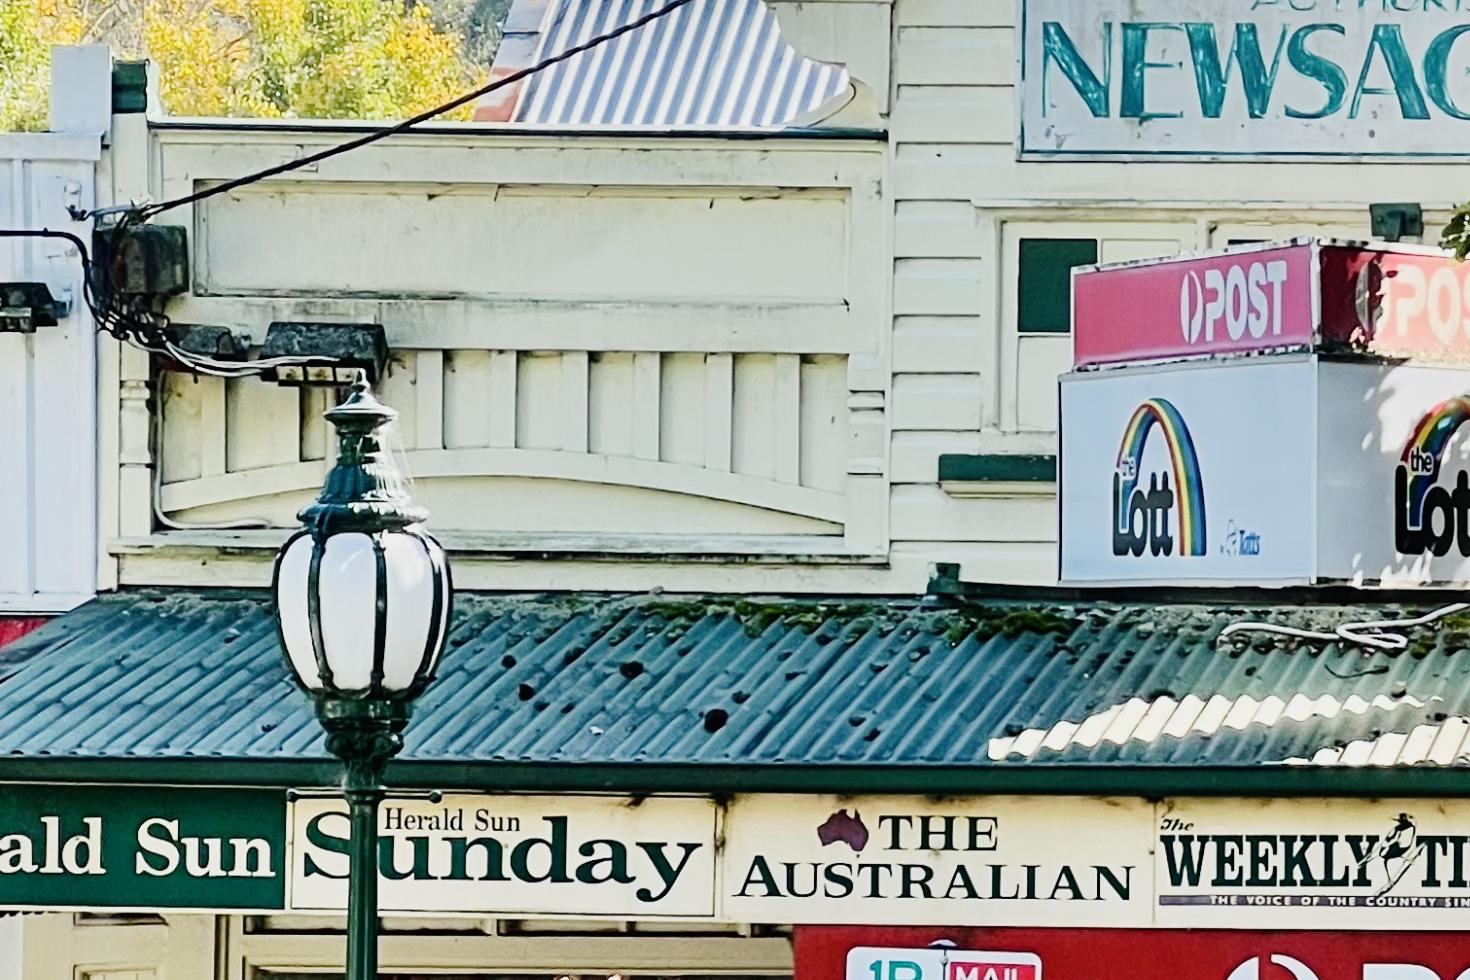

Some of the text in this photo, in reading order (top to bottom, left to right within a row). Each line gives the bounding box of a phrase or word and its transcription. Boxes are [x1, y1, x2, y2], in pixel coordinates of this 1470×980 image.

[1204, 261, 1288, 342] POST
[1121, 455, 1136, 475] the
[1410, 448, 1434, 473] the
[1112, 468, 1174, 556] Lott
[385, 808, 521, 832] Herald Sun
[878, 815, 998, 851] THE
[1160, 819, 1194, 832] The
[136, 817, 276, 877] Sun
[303, 812, 703, 902] Sunday
[1160, 835, 1379, 887] WEEKLY
[732, 855, 1136, 901] AUSTRALIAN
[1210, 895, 1238, 906] THE
[1246, 895, 1291, 906] VOICE
[1300, 896, 1319, 906] OF
[1328, 896, 1356, 907] THE
[1366, 896, 1436, 907] COUNTRY
